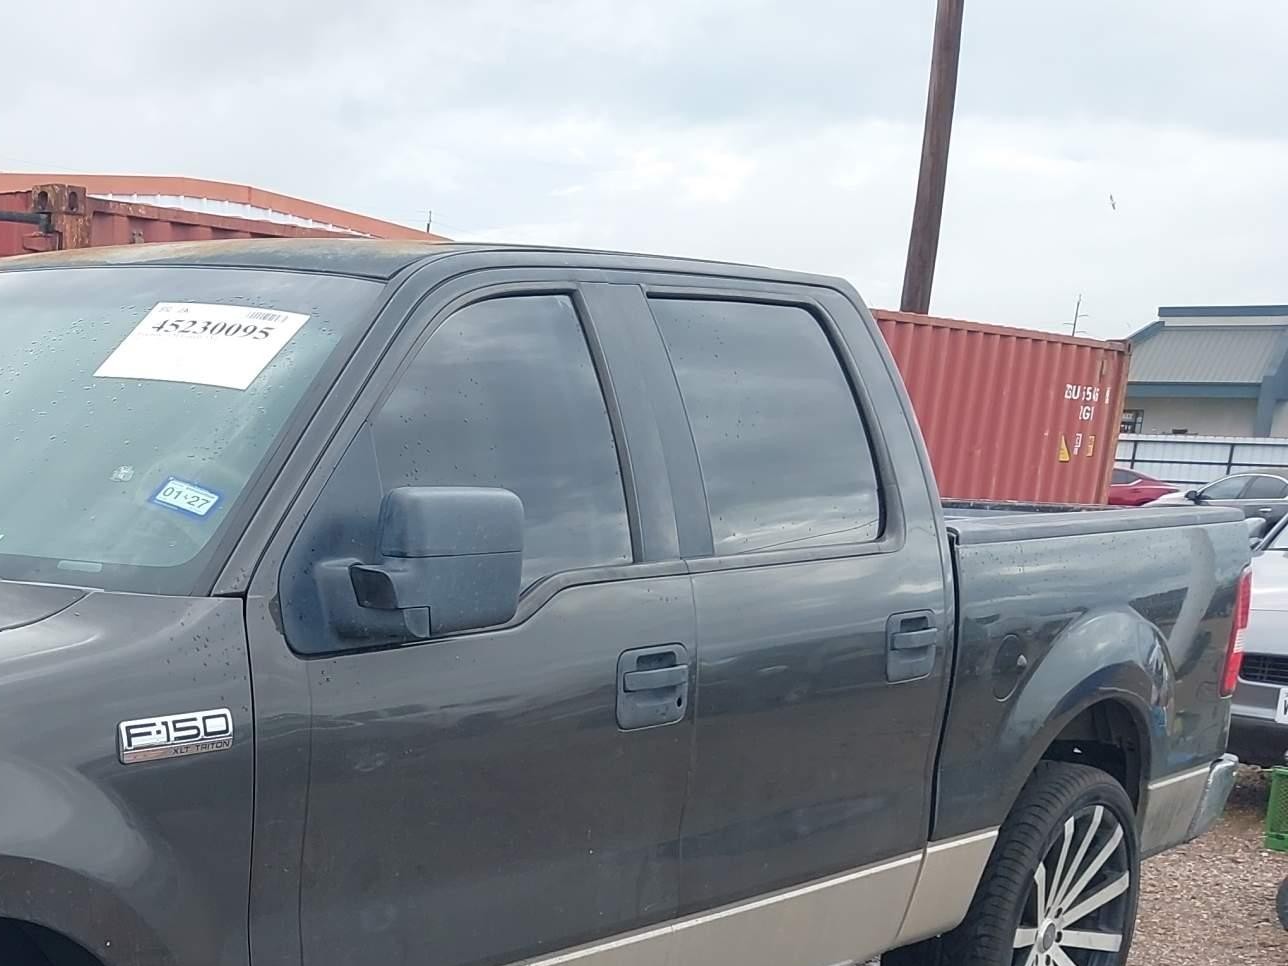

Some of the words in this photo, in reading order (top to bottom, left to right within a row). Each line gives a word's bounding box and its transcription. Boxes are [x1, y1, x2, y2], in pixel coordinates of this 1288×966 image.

[151, 319, 275, 340] 45230095
[172, 746, 189, 755] XLT
[196, 740, 230, 751] TRITON
